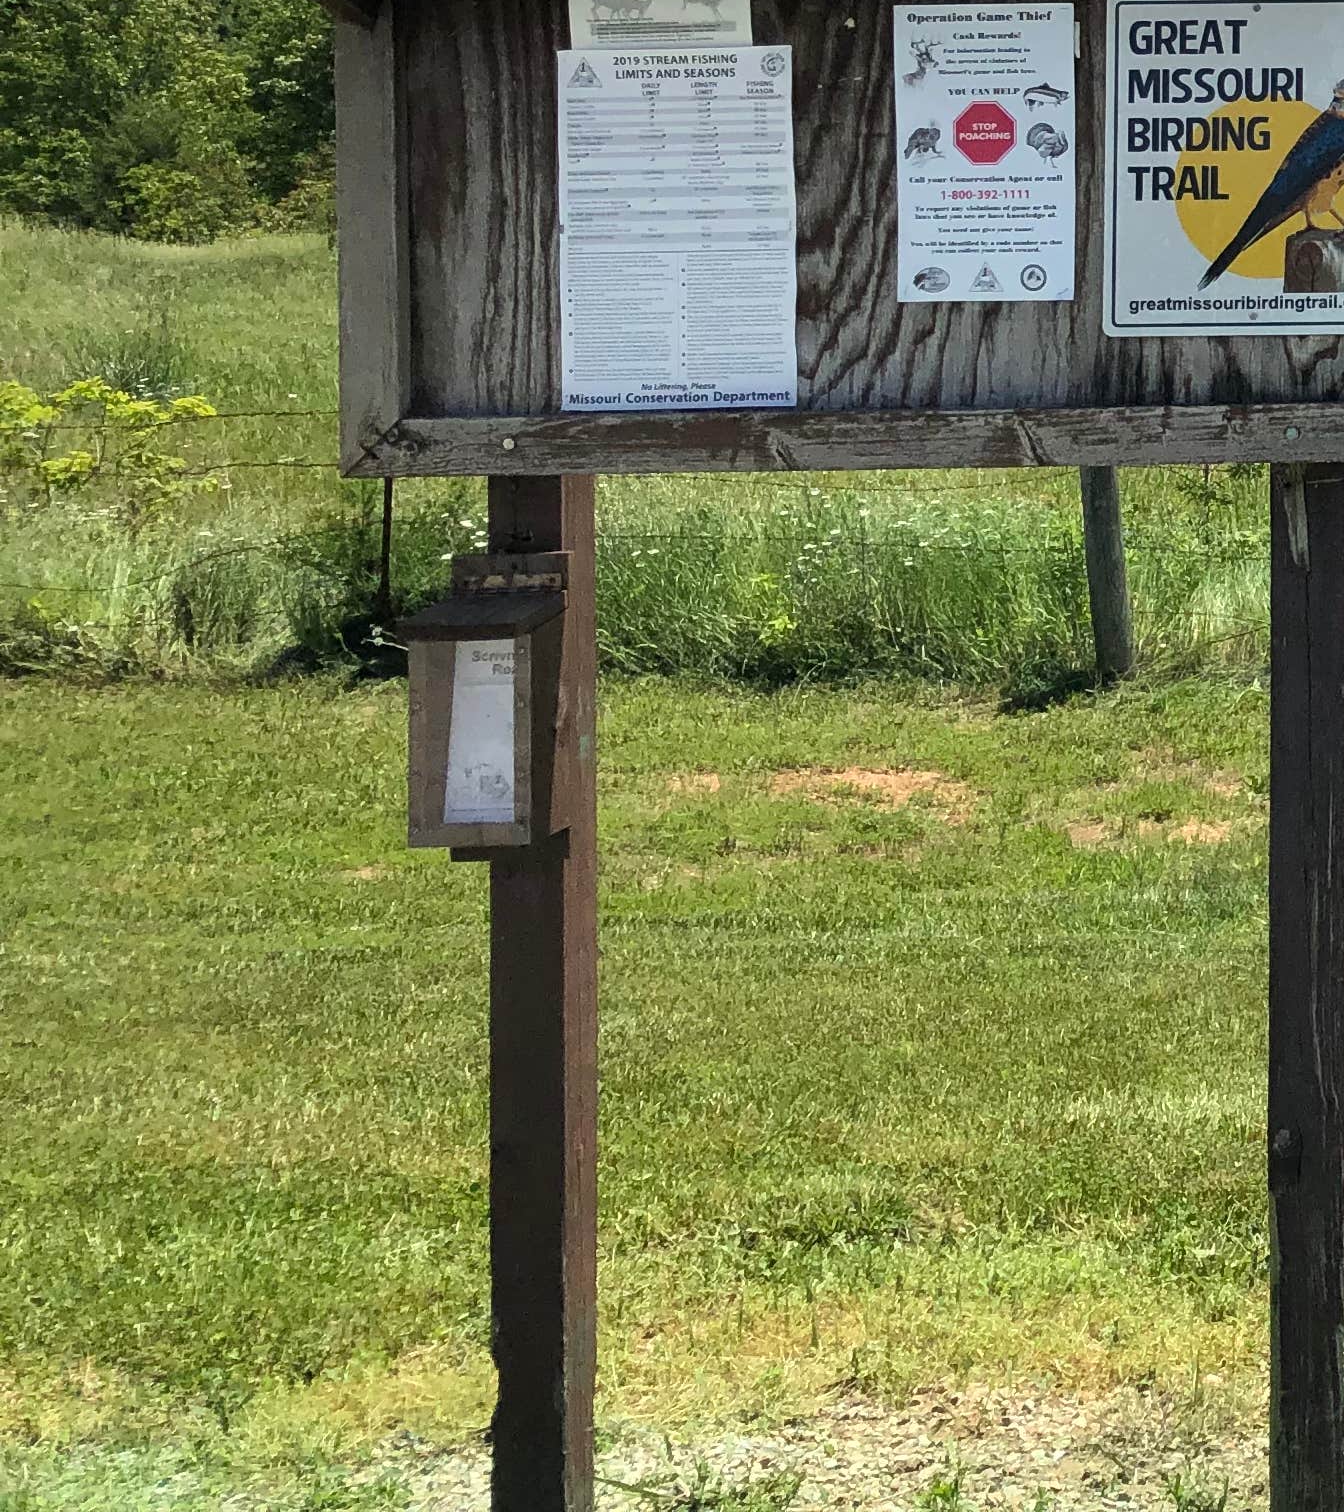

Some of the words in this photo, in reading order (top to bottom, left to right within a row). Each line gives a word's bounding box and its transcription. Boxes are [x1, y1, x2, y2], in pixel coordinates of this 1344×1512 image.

[906, 11, 972, 25] Operation
[976, 11, 1012, 22] Game
[1016, 10, 1052, 21] Thief
[1129, 19, 1247, 54] GREAT
[613, 56, 640, 66] 2019
[642, 55, 689, 65] STREAM
[691, 53, 737, 64] FISHING
[615, 69, 652, 79] LIMITS
[655, 68, 680, 78] AND
[683, 67, 735, 78] SEASONS
[1128, 68, 1303, 104] MISSOURI
[972, 122, 997, 130] STOP
[959, 132, 1010, 140] POACHING
[1128, 117, 1270, 152] BIRDING
[1007, 175, 1032, 183] Agent
[1128, 166, 1229, 201] TRAIL
[940, 189, 1029, 200] 1-800-392-1111
[653, 382, 688, 392] Littering,
[567, 392, 620, 405] Missouri
[625, 391, 708, 405] Conservation
[712, 390, 790, 404] Department
